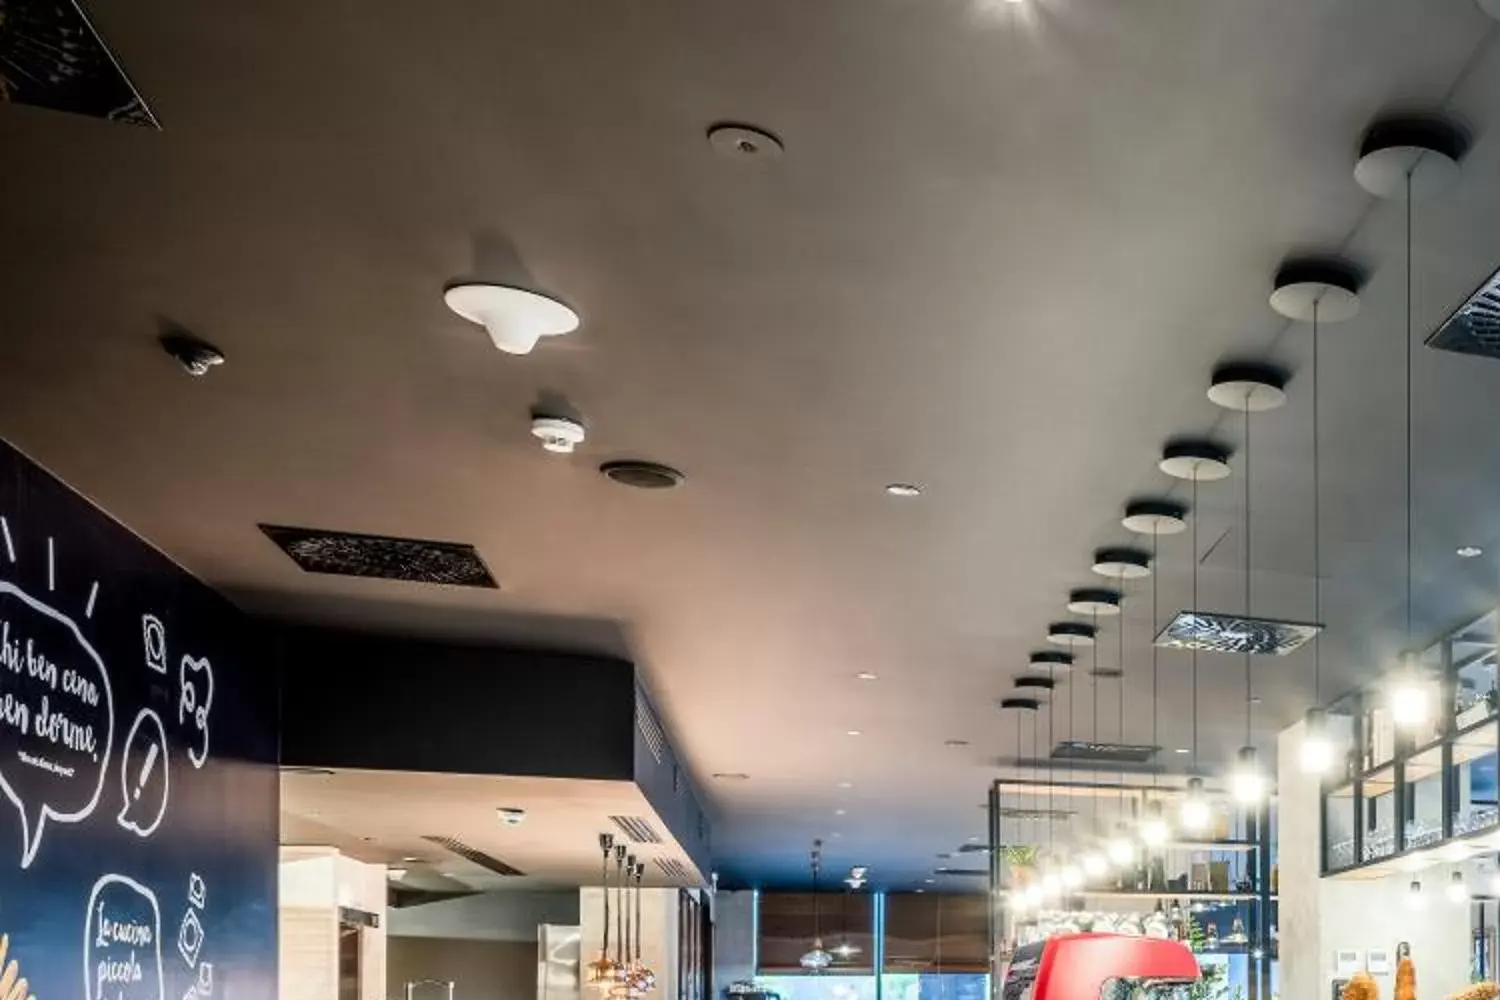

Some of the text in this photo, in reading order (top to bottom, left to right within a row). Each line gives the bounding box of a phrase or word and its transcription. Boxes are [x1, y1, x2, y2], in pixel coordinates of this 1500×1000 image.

[0, 621, 100, 707] hi ben cena
[0, 693, 29, 735] en
[97, 949, 142, 1000] piccola
